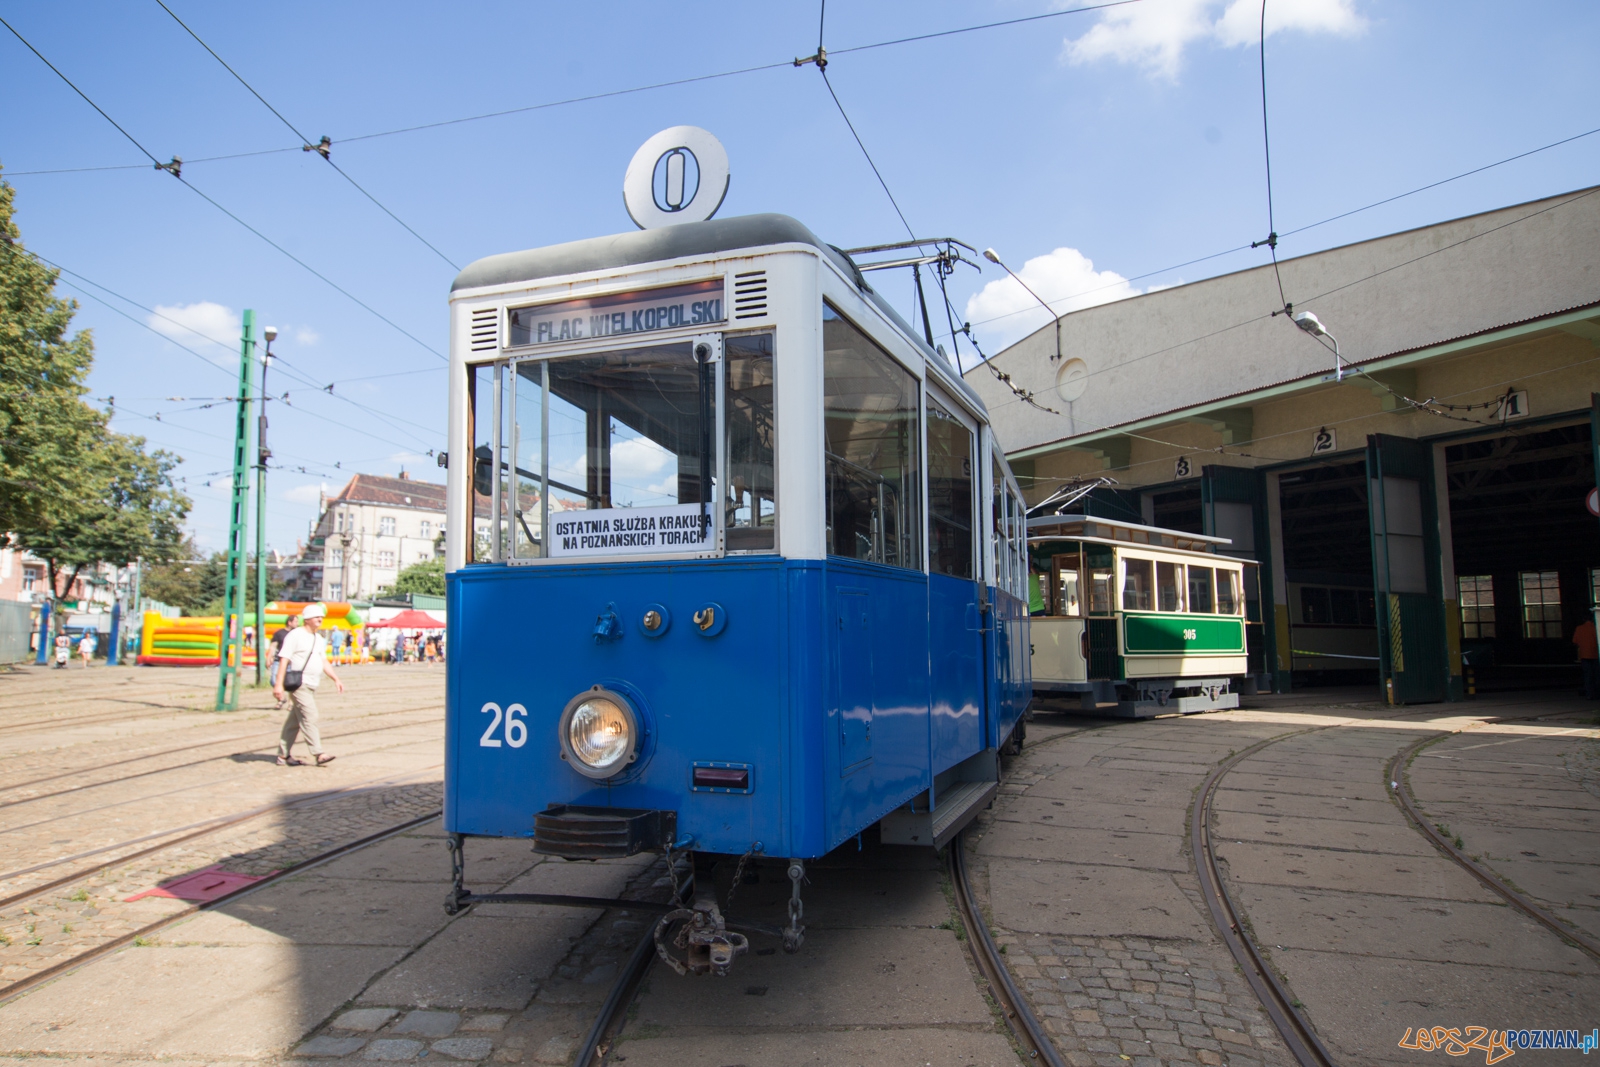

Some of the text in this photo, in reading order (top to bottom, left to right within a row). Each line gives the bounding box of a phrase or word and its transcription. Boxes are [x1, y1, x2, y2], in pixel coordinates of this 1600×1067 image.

[537, 299, 721, 343] PLAC WIELKOPOLSKI
[1507, 394, 1521, 416] 1
[1316, 433, 1332, 451] 2
[1177, 460, 1190, 477] 3
[556, 519, 610, 536] OSTATNIA
[613, 516, 656, 532] SŁUŻBA
[563, 530, 705, 550] NA POZNAŃSKICH TORACH
[1183, 628, 1197, 640] 305
[479, 702, 528, 748] 26
